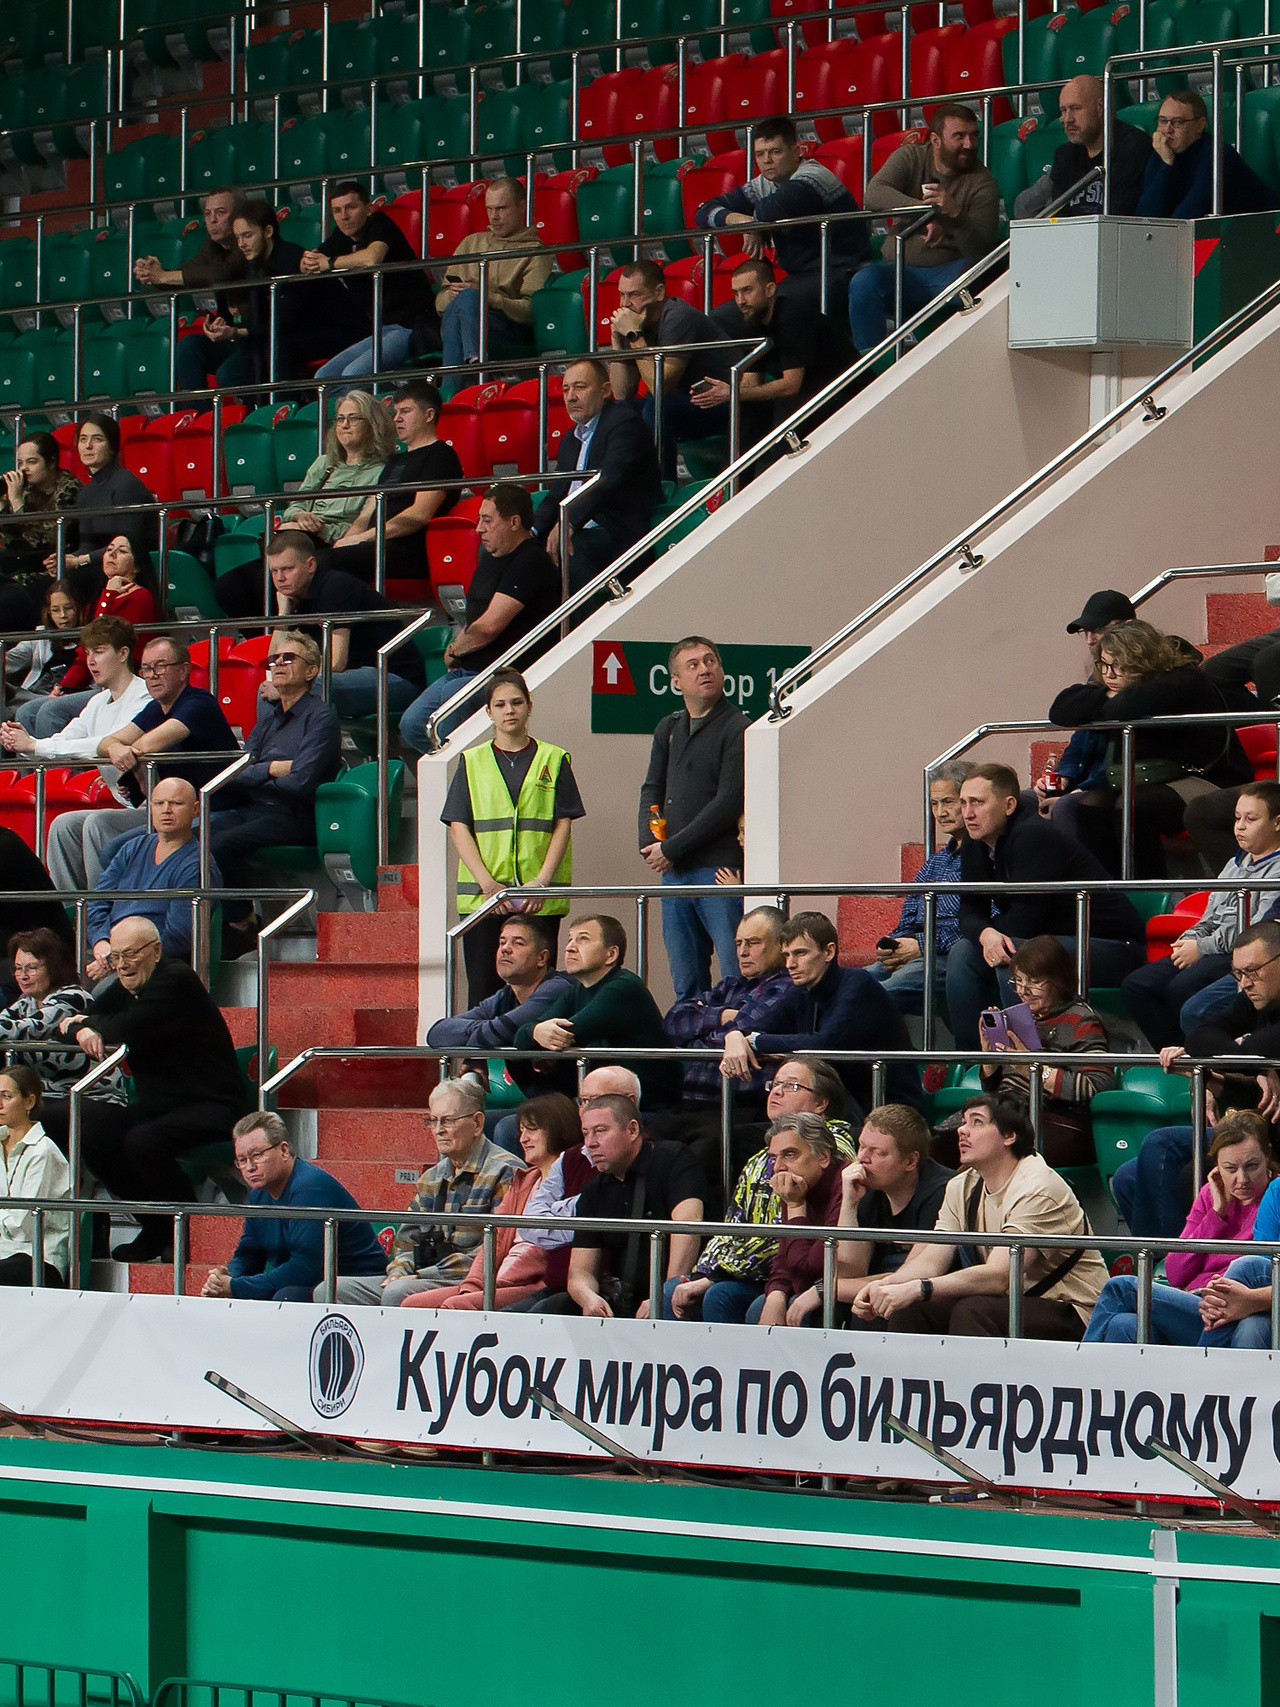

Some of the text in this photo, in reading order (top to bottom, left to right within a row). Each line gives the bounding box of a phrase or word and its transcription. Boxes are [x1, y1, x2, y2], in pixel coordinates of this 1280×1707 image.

[649, 664, 754, 705] Сор
[319, 1319, 354, 1341] БИЛЬЯРД
[316, 1398, 346, 1413] СИБИРИ
[397, 1329, 566, 1435] Кубок
[577, 1360, 723, 1451] мира
[737, 1369, 807, 1438] по
[821, 1352, 1253, 1485] бильярдному
